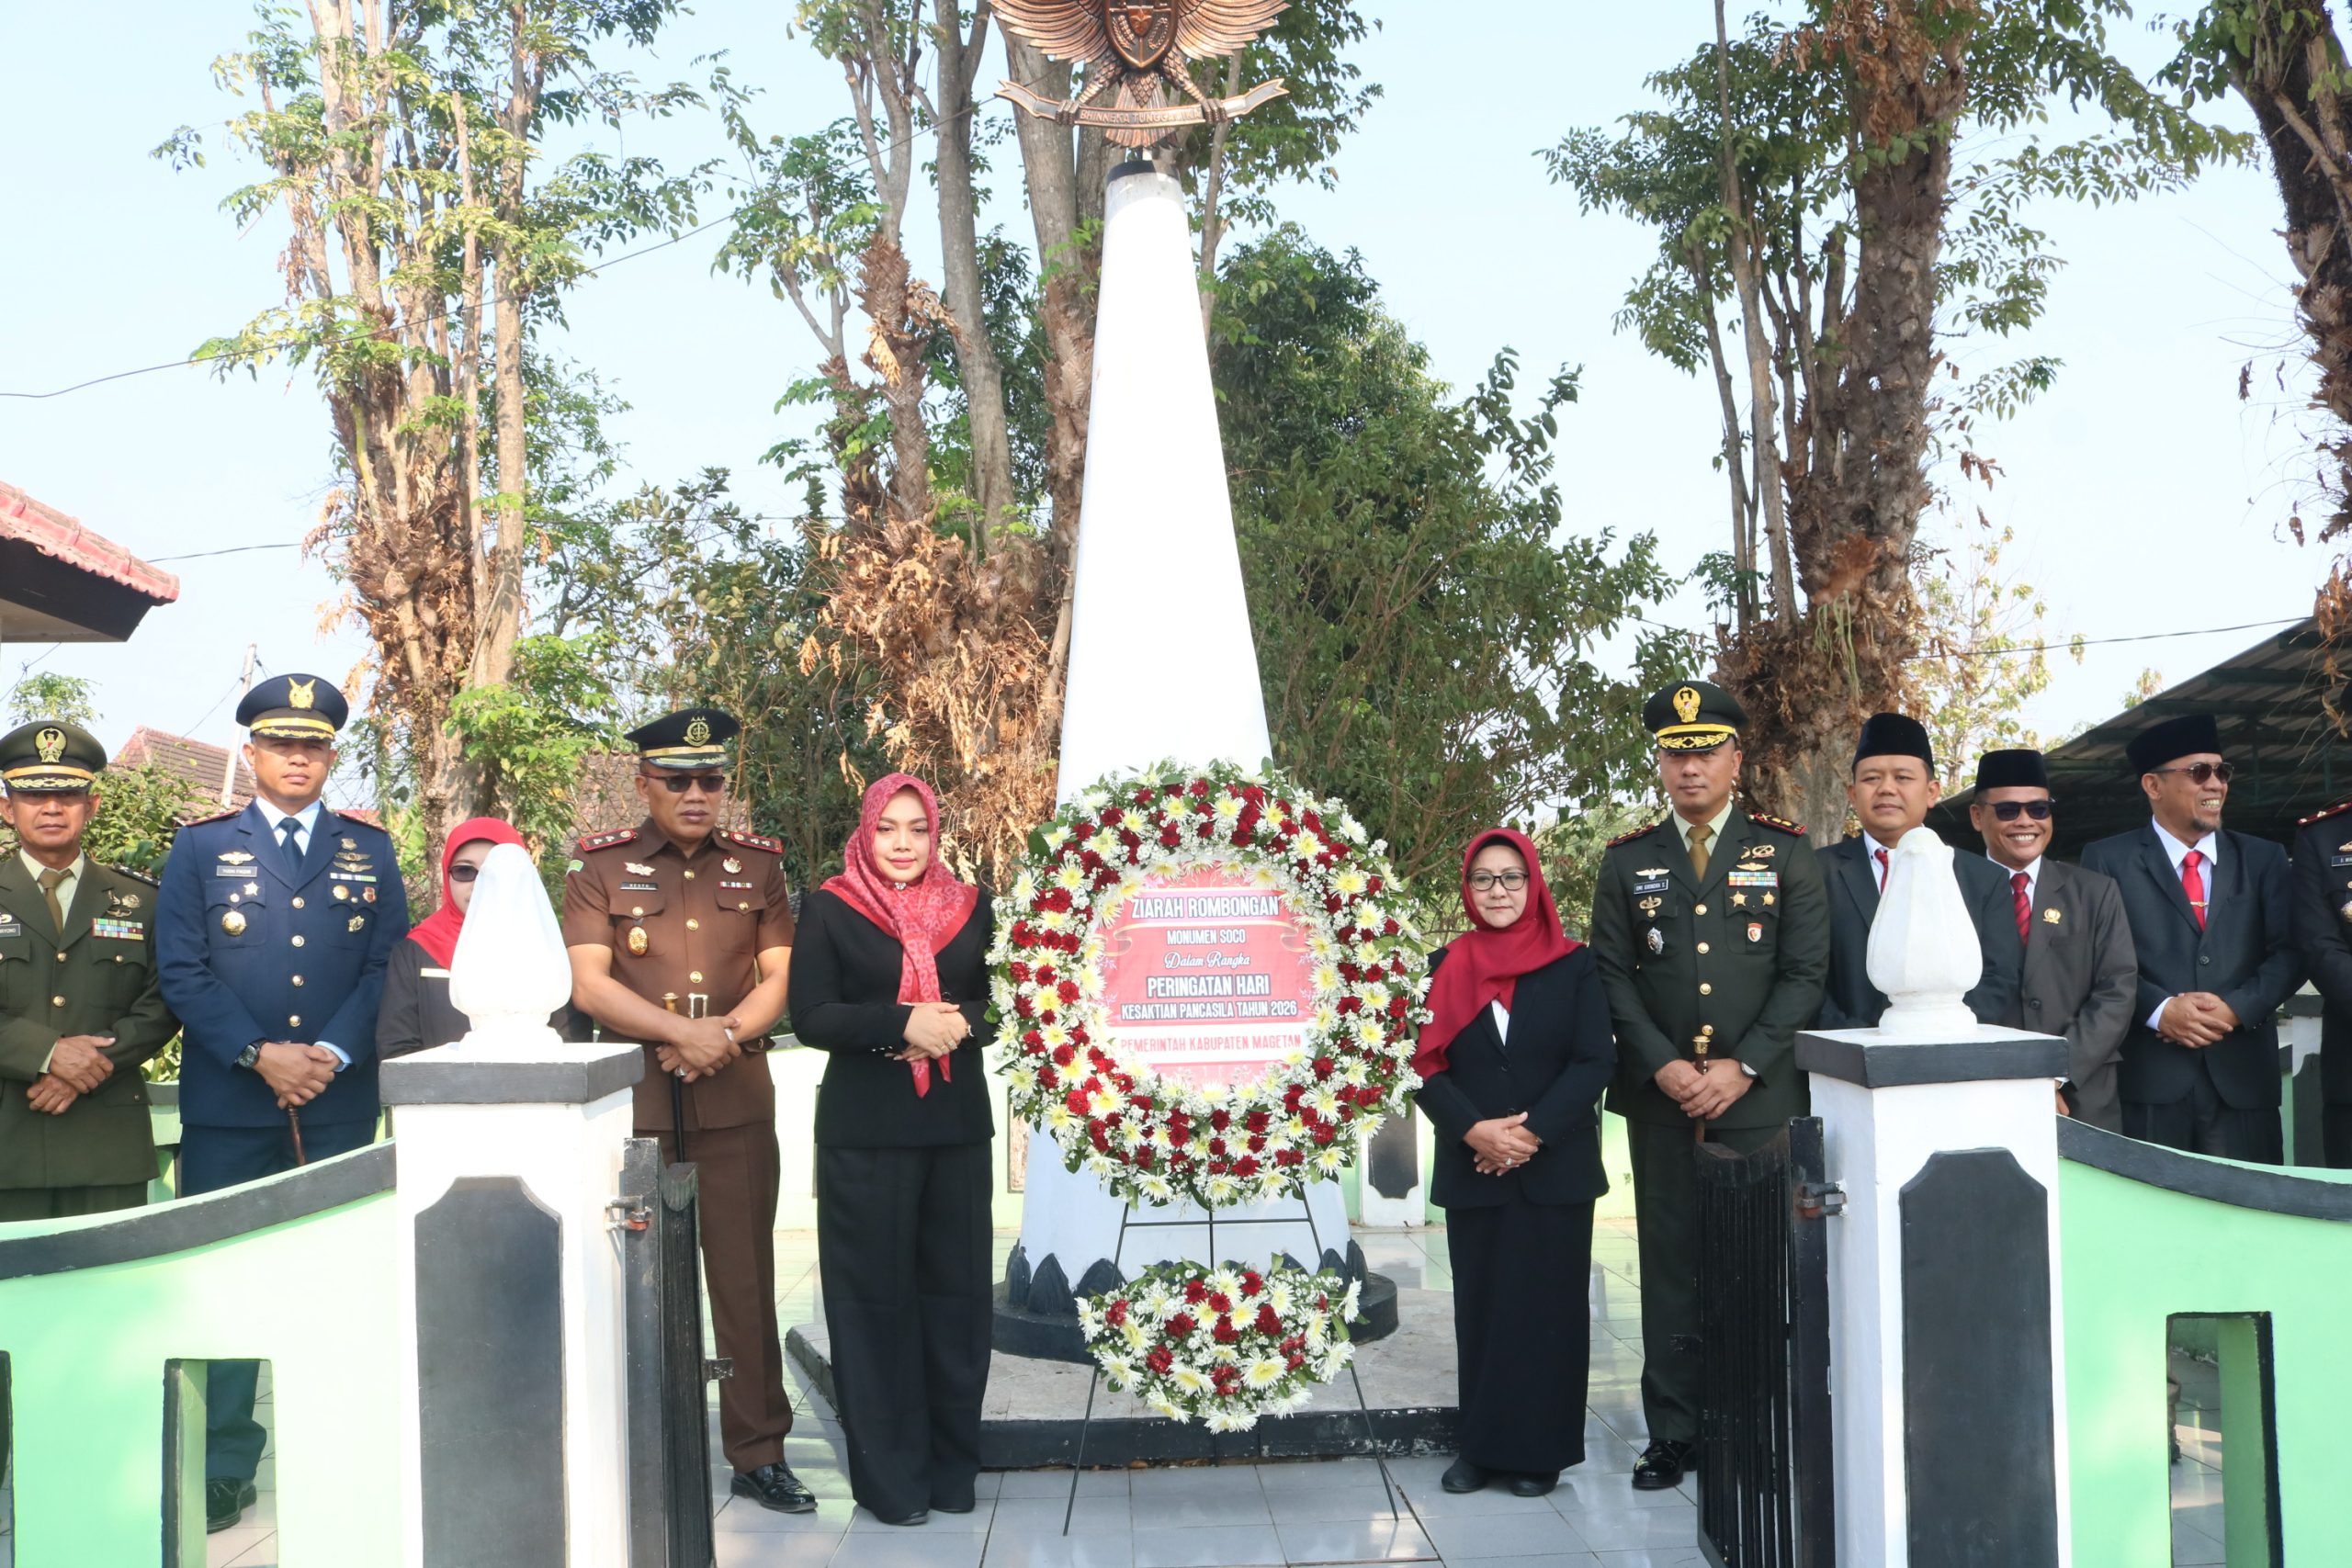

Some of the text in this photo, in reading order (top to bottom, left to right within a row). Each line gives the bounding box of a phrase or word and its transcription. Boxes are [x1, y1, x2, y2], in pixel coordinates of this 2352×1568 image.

[1080, 109, 1130, 122] BHINNEKA
[1131, 895, 1280, 919] ZIARAH ROMBONGAN
[1166, 928, 1246, 946] MONUMEN SOCO
[1164, 951, 1250, 969] Dalam Rangka
[1147, 974, 1271, 998] PERINGATAN HARI
[1121, 999, 1298, 1021] KESAKTIAN PANCASILA TAHUN 2026
[1120, 1034, 1302, 1053] PEMERINTAH KABUPATEN MAGETAN
